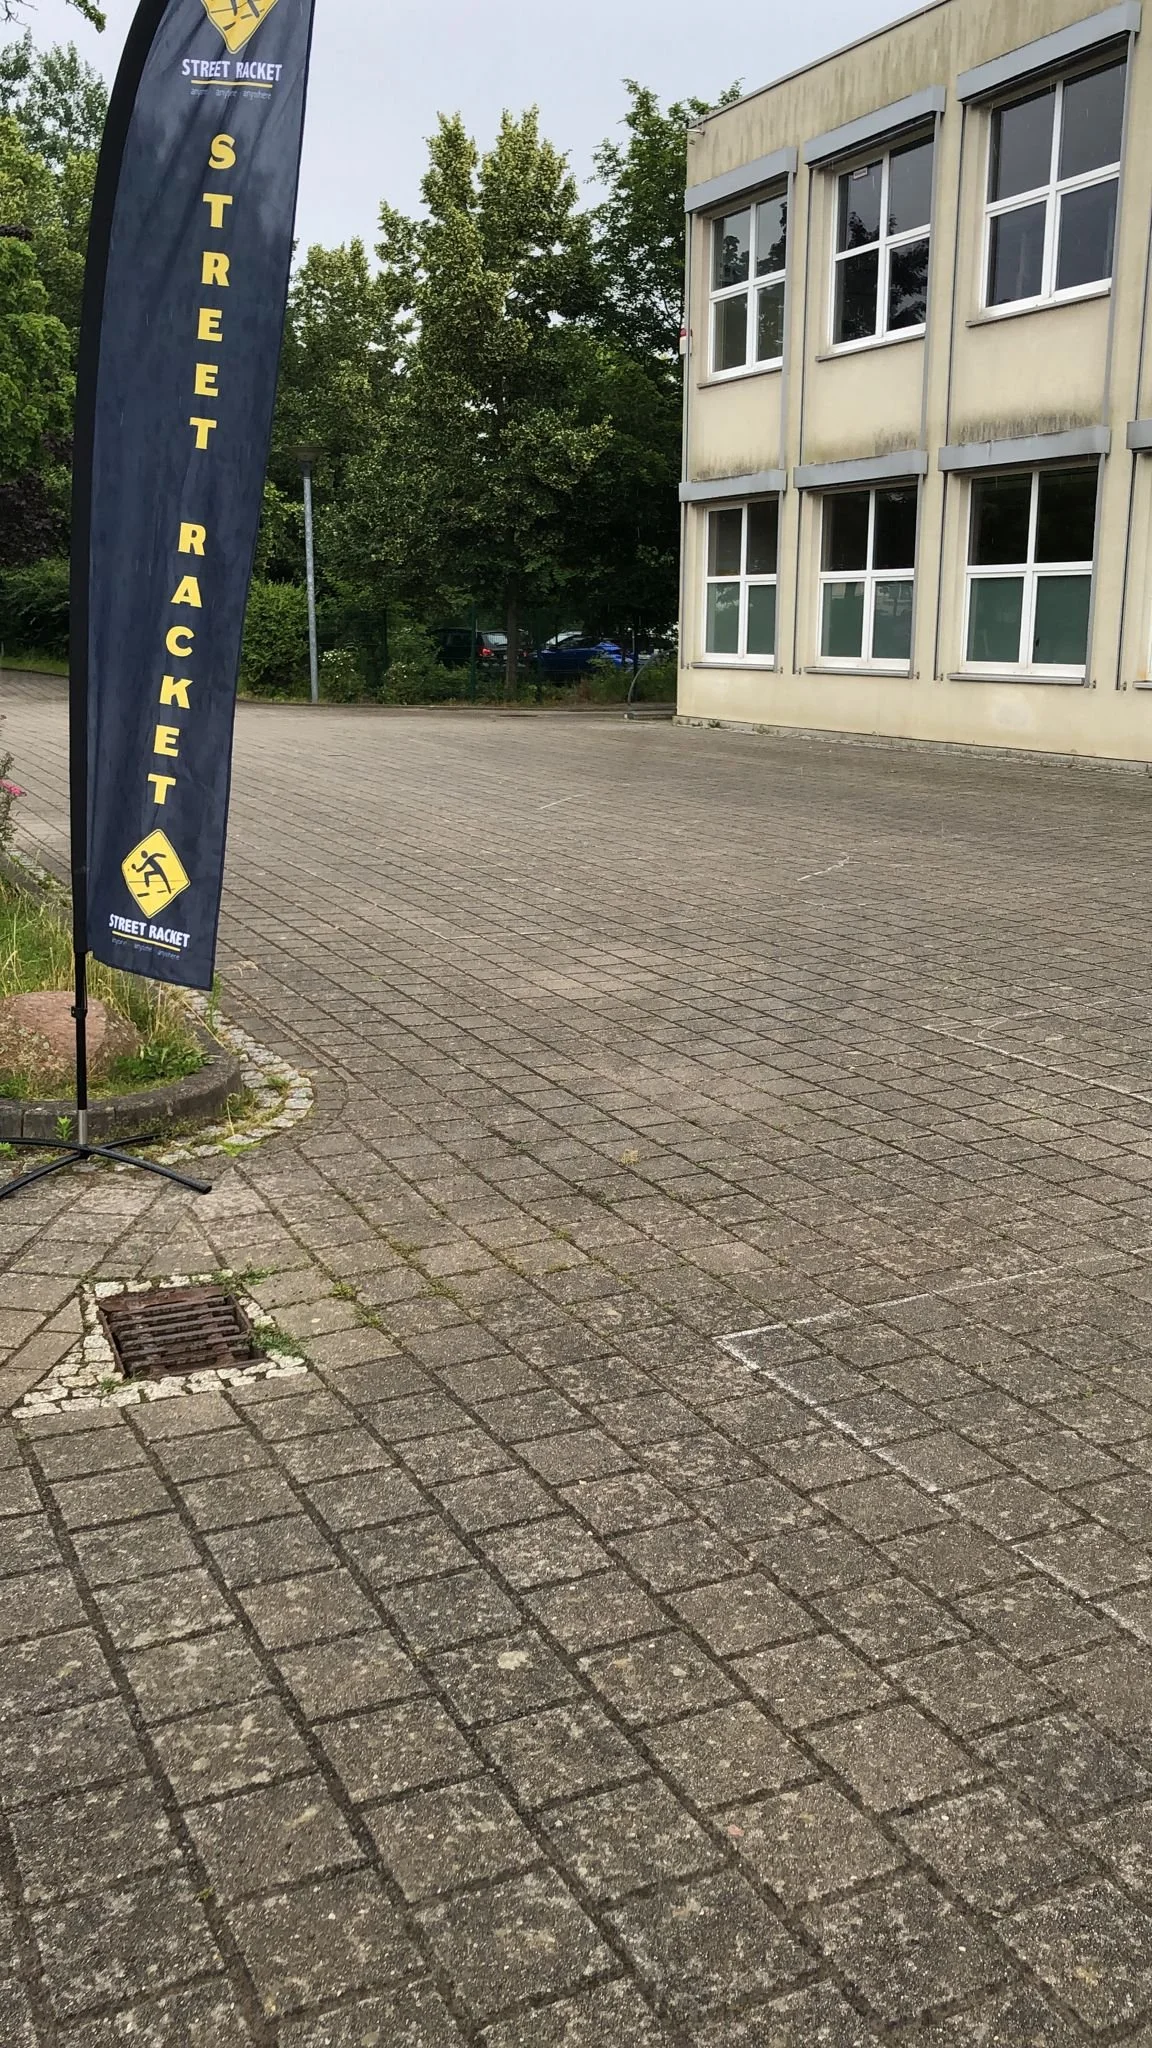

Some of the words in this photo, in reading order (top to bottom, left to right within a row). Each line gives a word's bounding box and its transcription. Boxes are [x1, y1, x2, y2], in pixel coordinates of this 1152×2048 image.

[182, 59, 230, 78] STREET
[236, 61, 283, 81] RACKET
[190, 133, 236, 450] STREET
[147, 522, 207, 805] RACKET
[109, 913, 147, 936] STREET
[148, 924, 191, 948] RACKET
